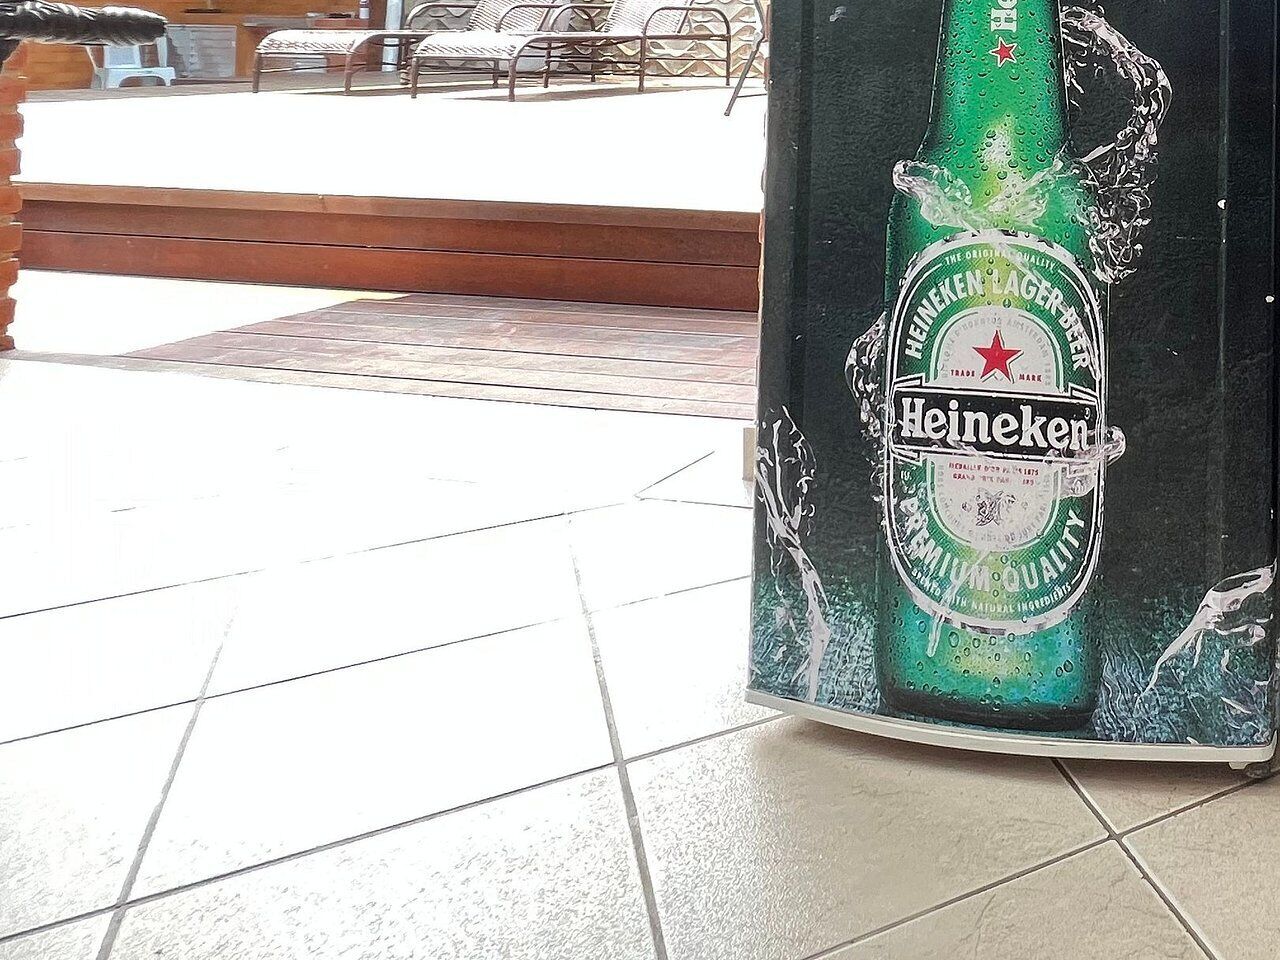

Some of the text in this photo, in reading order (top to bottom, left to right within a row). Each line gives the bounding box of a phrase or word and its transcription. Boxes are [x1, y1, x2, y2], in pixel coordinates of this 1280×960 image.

[945, 252, 961, 265] THE
[1018, 251, 1056, 274] QUALITY
[905, 269, 985, 360] HEINEKEN
[993, 270, 1064, 316] LAGER
[1058, 305, 1090, 372] BEER
[951, 369, 1042, 382] TRADE MARK
[900, 397, 1089, 451] Heineken
[1002, 509, 1085, 592] QUALITY
[971, 601, 1015, 614] NATURAL
[1017, 582, 1072, 613] INGREDIENTS
